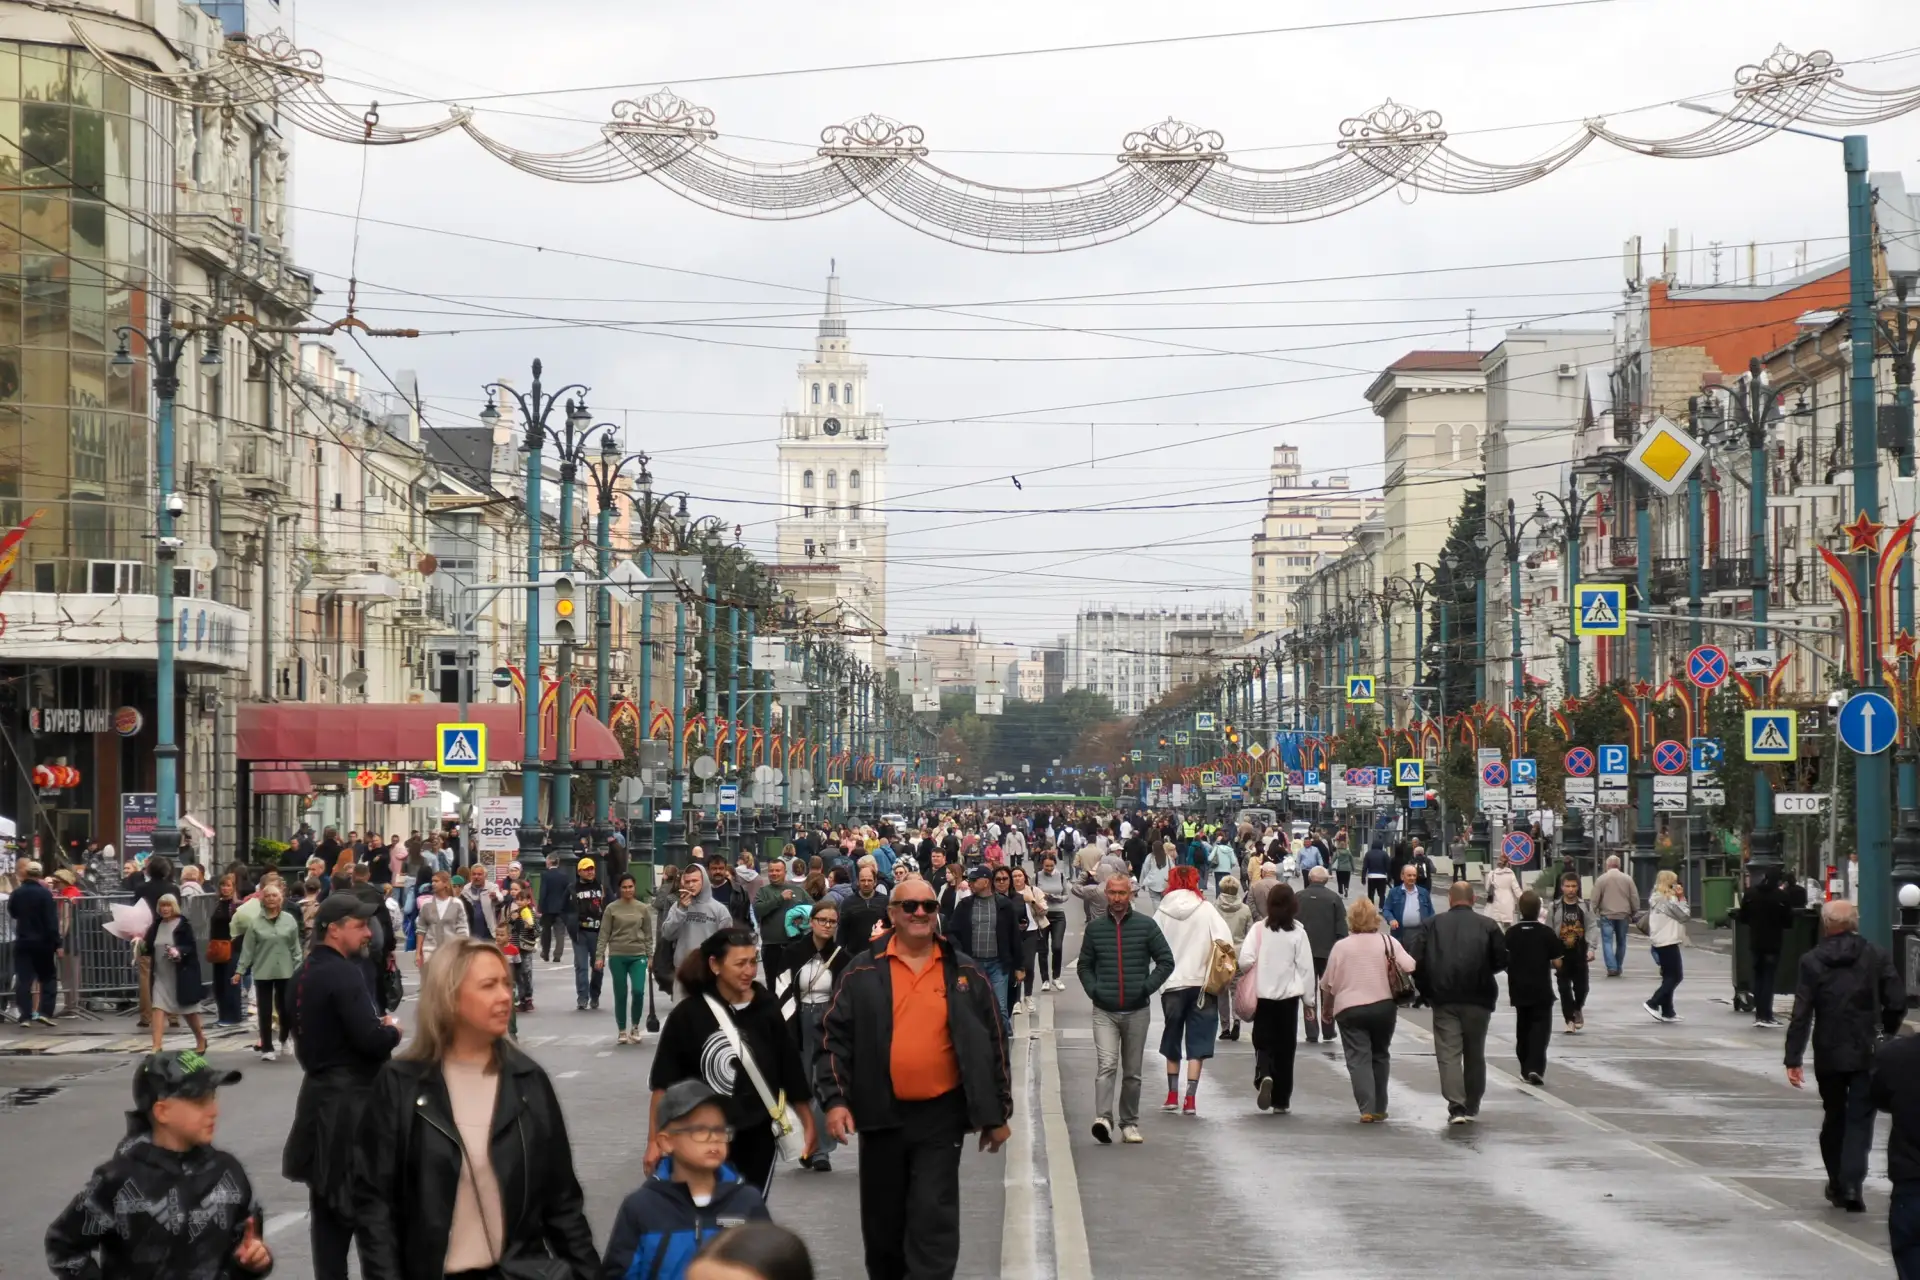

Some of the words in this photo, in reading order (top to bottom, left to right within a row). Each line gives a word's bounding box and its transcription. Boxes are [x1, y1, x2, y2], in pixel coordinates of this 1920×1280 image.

[44, 708, 81, 732] БУРГЕР
[84, 709, 110, 732] КИНГ
[1607, 749, 1623, 772] P
[376, 771, 389, 780] 24
[1517, 762, 1532, 781] P
[129, 796, 135, 805] 5
[1784, 798, 1827, 810] СТО
